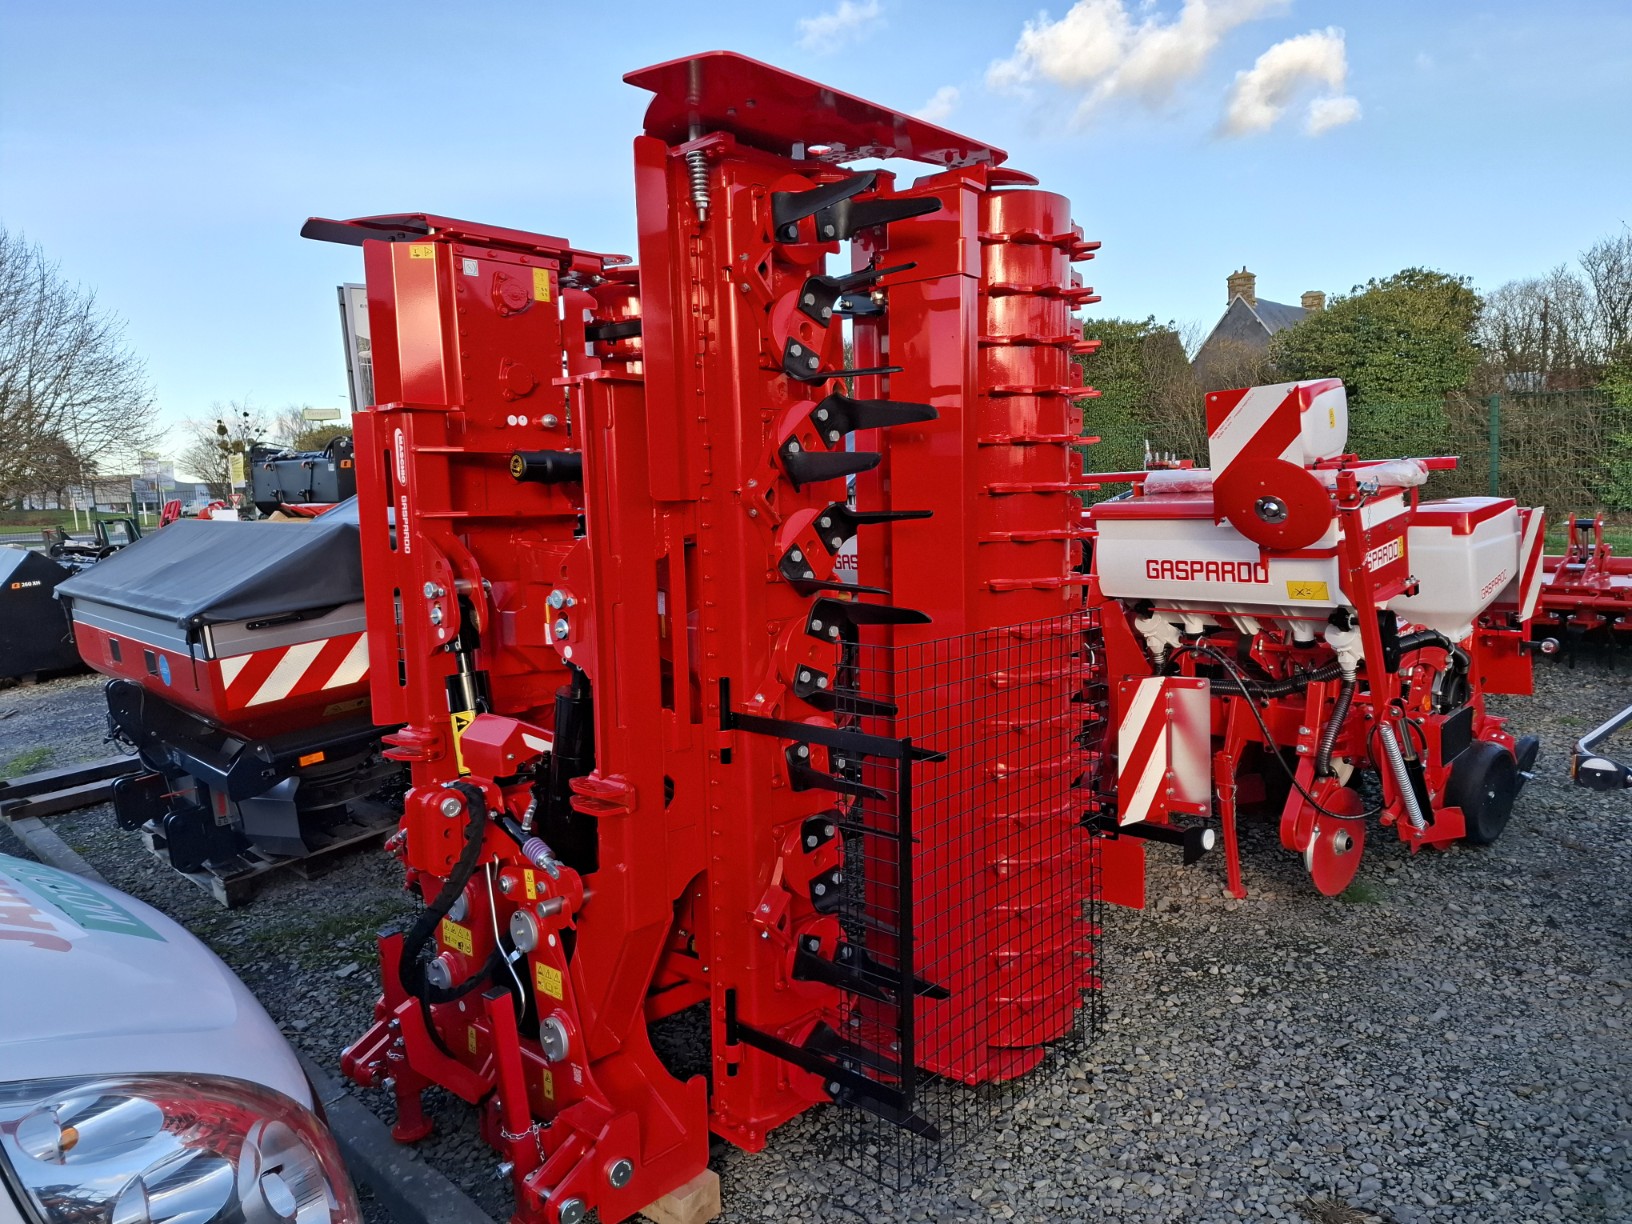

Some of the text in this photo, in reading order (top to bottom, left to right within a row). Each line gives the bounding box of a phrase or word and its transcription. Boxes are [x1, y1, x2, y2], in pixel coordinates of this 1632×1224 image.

[398, 434, 407, 484] MASCHIO
[401, 495, 411, 554] GASPARDO
[835, 554, 858, 570] GAS
[1367, 540, 1398, 570] SPARDO
[1145, 559, 1269, 583] GASPARDO
